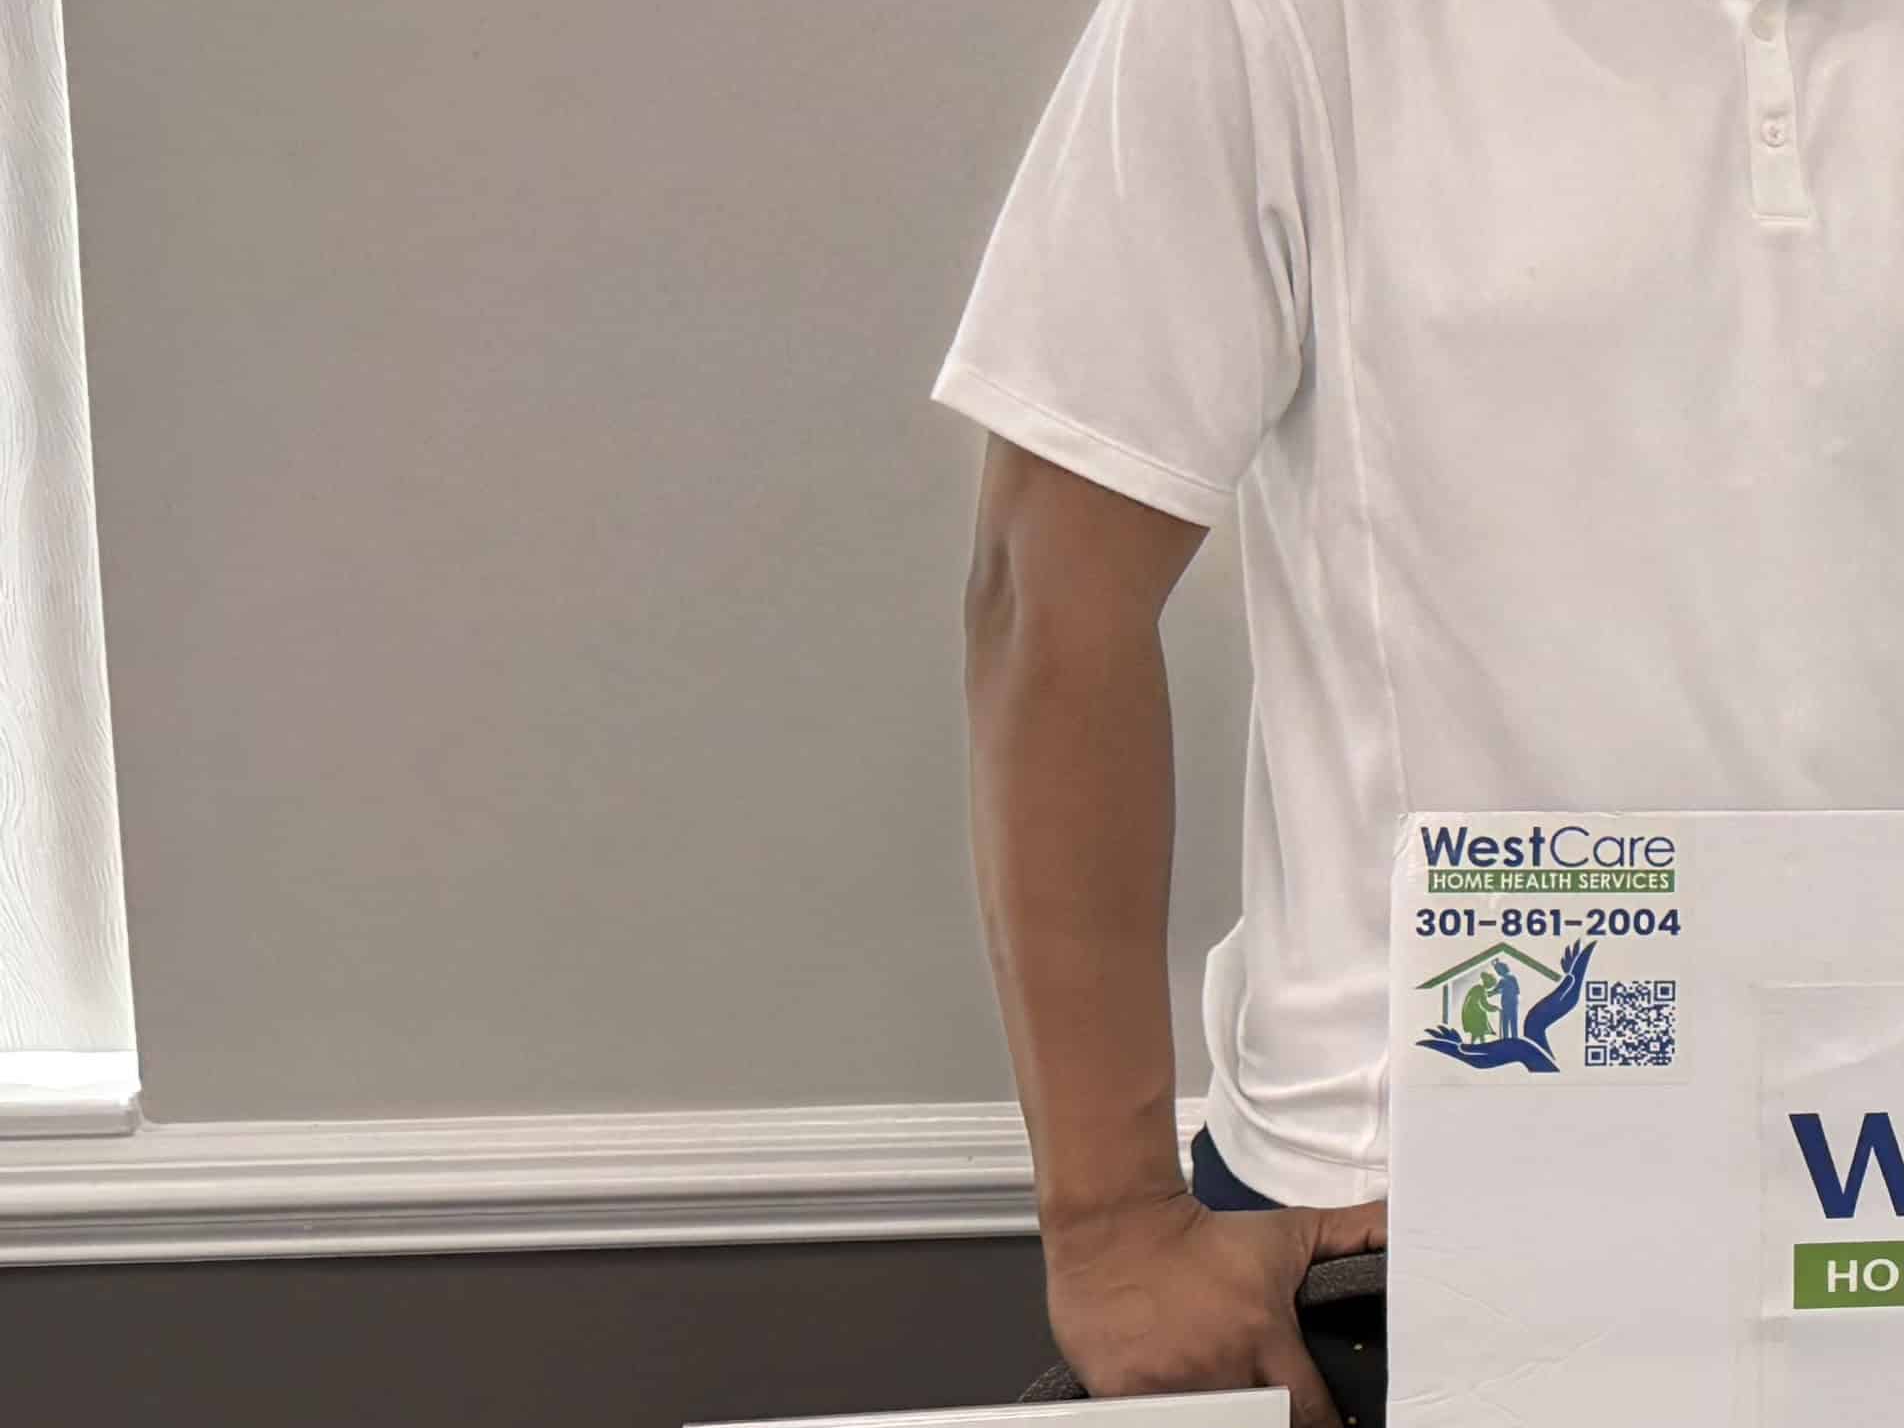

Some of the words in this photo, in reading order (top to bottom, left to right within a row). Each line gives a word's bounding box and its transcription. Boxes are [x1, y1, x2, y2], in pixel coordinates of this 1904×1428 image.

[1419, 826, 1676, 868] WestCare
[1433, 873, 1496, 891] HOME
[1502, 873, 1573, 891] HEALTH
[1578, 873, 1670, 891] SERVICES
[1415, 908, 1681, 936] 301-861-2004
